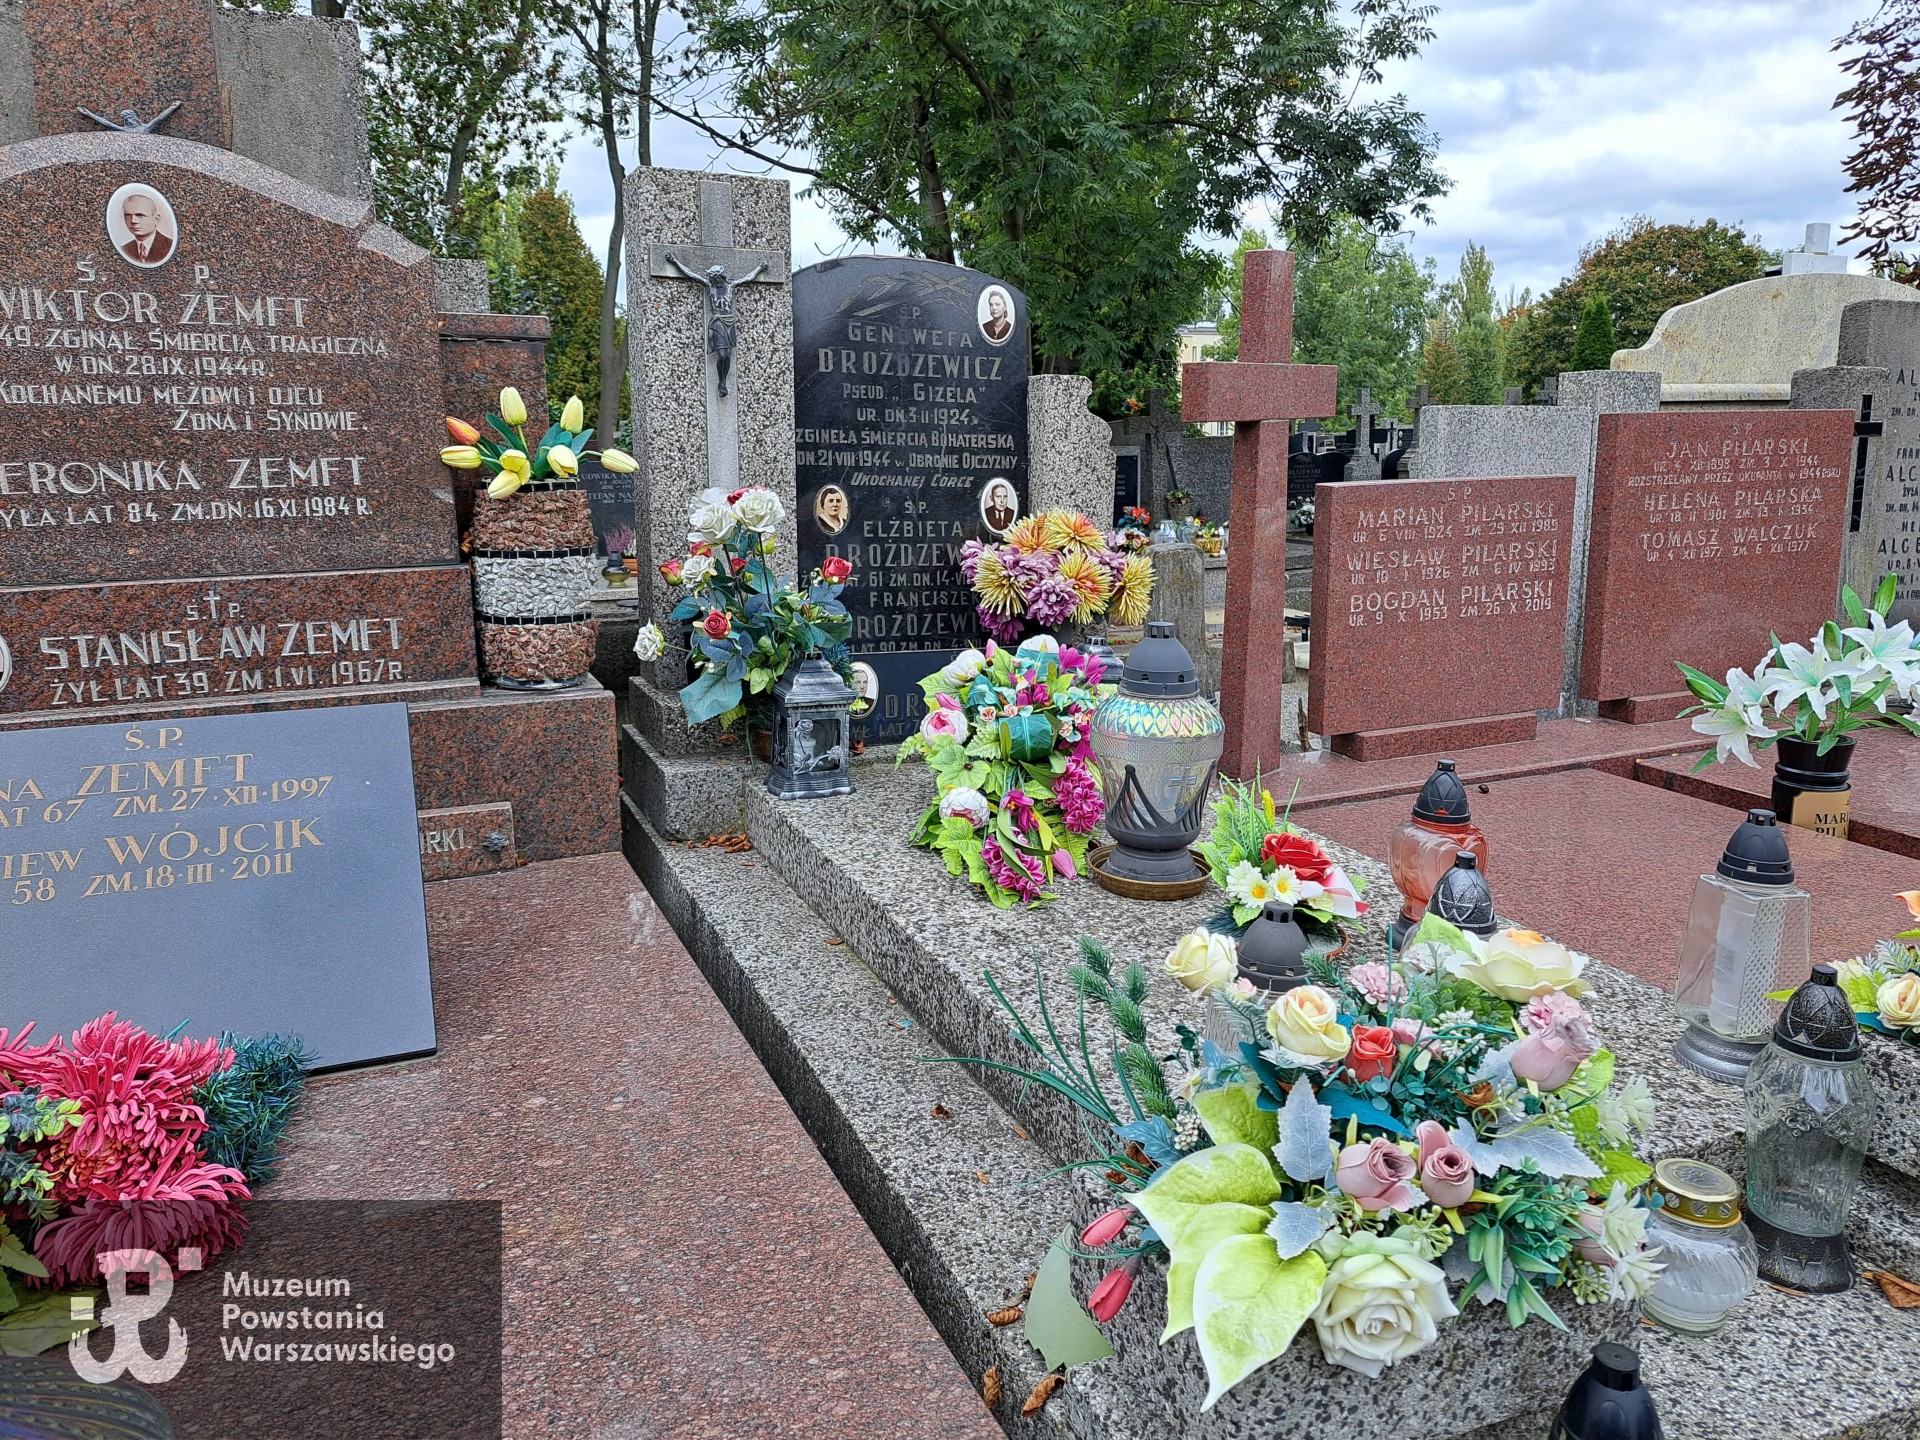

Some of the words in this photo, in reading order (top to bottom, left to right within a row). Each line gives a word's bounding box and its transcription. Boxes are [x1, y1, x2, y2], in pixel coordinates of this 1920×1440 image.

[178, 293, 309, 328] ZEMFT
[46, 328, 139, 354] ZGINĄŁ
[149, 328, 256, 355] ŚMIERCIĄ
[267, 335, 390, 358] TRAGICZNĄ
[55, 356, 73, 374] W
[0, 380, 142, 405] KOCHANEMU
[268, 386, 323, 406] OJCU
[266, 409, 369, 431] SYNOWIE.
[962, 451, 1018, 471] OJCZYZNY
[1666, 441, 1709, 458] JAN
[1722, 437, 1808, 456] PILARSKI
[0, 460, 202, 495] ERONIKA
[227, 455, 367, 489] ZEMFT
[850, 471, 926, 490] UKOCHANEJ
[1704, 472, 1733, 483] PRZEZ
[1885, 465, 1918, 482] ALC
[1645, 491, 1719, 511] HELENA
[1735, 487, 1823, 505] PILARSKA
[0, 508, 58, 529] YŁA
[67, 505, 115, 526] LAT
[127, 502, 159, 523] 84
[1358, 506, 1444, 528] MARIAN
[1461, 501, 1554, 522] PILARSKI
[1640, 529, 1719, 549] TOMASZ
[1733, 523, 1818, 543] WALCZUK
[825, 538, 964, 568] DROŻDZEW
[1347, 546, 1446, 571] WIESŁAW
[1462, 539, 1557, 563] PILARSKI
[1350, 588, 1445, 613] BOGDAN
[1461, 580, 1552, 603] PILARSKI
[1486, 602, 1501, 615] 26
[1525, 598, 1552, 612] 2019
[850, 610, 985, 639] ROŻDZEWI
[39, 624, 267, 670] STANISŁAW
[278, 618, 404, 656] ZEMFT
[50, 679, 109, 705] ŻYŁ
[115, 675, 168, 701] LAT
[77, 753, 254, 797] ZEMFT
[43, 798, 86, 824] 67
[112, 794, 164, 818] ZM.
[1814, 811, 1849, 825] MAR
[1, 848, 87, 880] IEW
[104, 816, 325, 866] WÓJCIK
[11, 877, 56, 905] 58
[80, 871, 139, 898] ZM.
